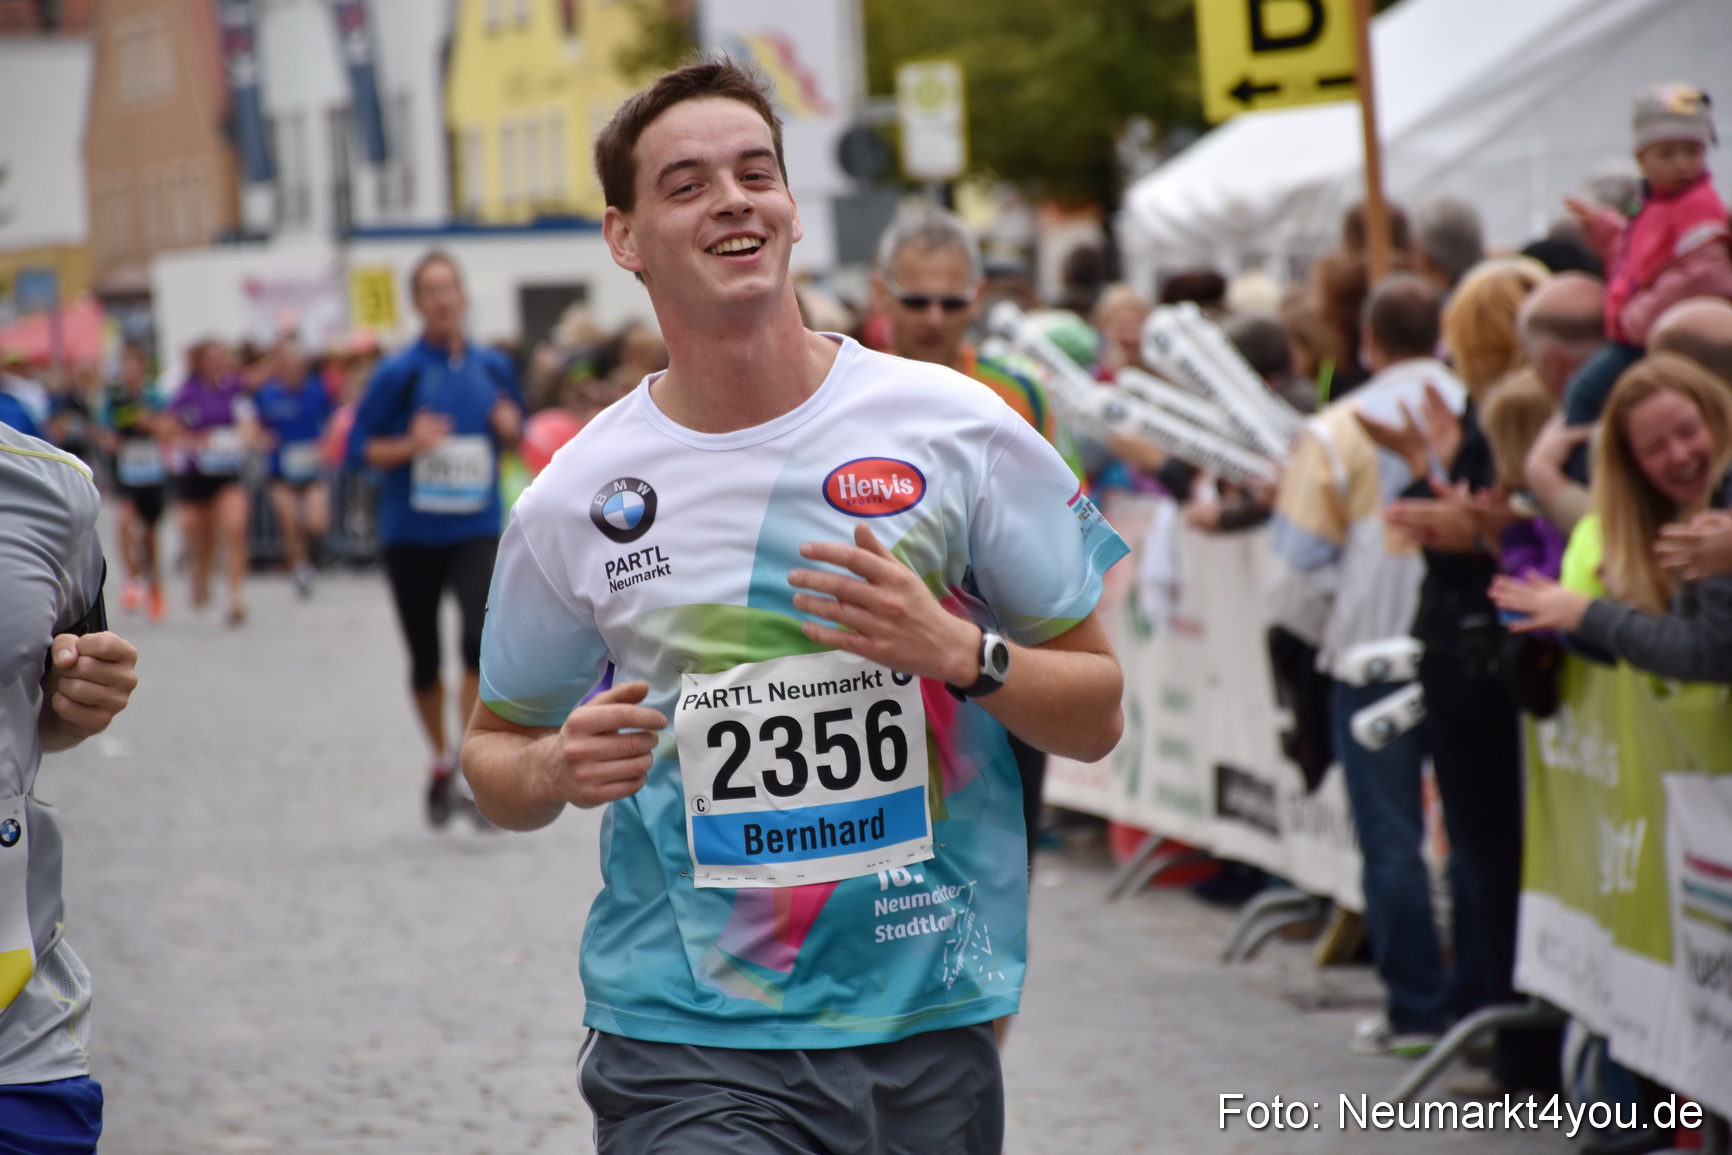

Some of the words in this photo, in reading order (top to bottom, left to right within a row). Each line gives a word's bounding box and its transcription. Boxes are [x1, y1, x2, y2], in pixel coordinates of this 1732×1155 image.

[594, 479, 651, 506] BMW
[838, 473, 914, 500] Hervis
[605, 545, 670, 580] PARTL
[608, 563, 672, 594] Neumarkt
[682, 684, 763, 711] PARTL
[768, 669, 883, 702] Neumarkt
[706, 699, 909, 801] 2356
[743, 807, 886, 856] Bernhard
